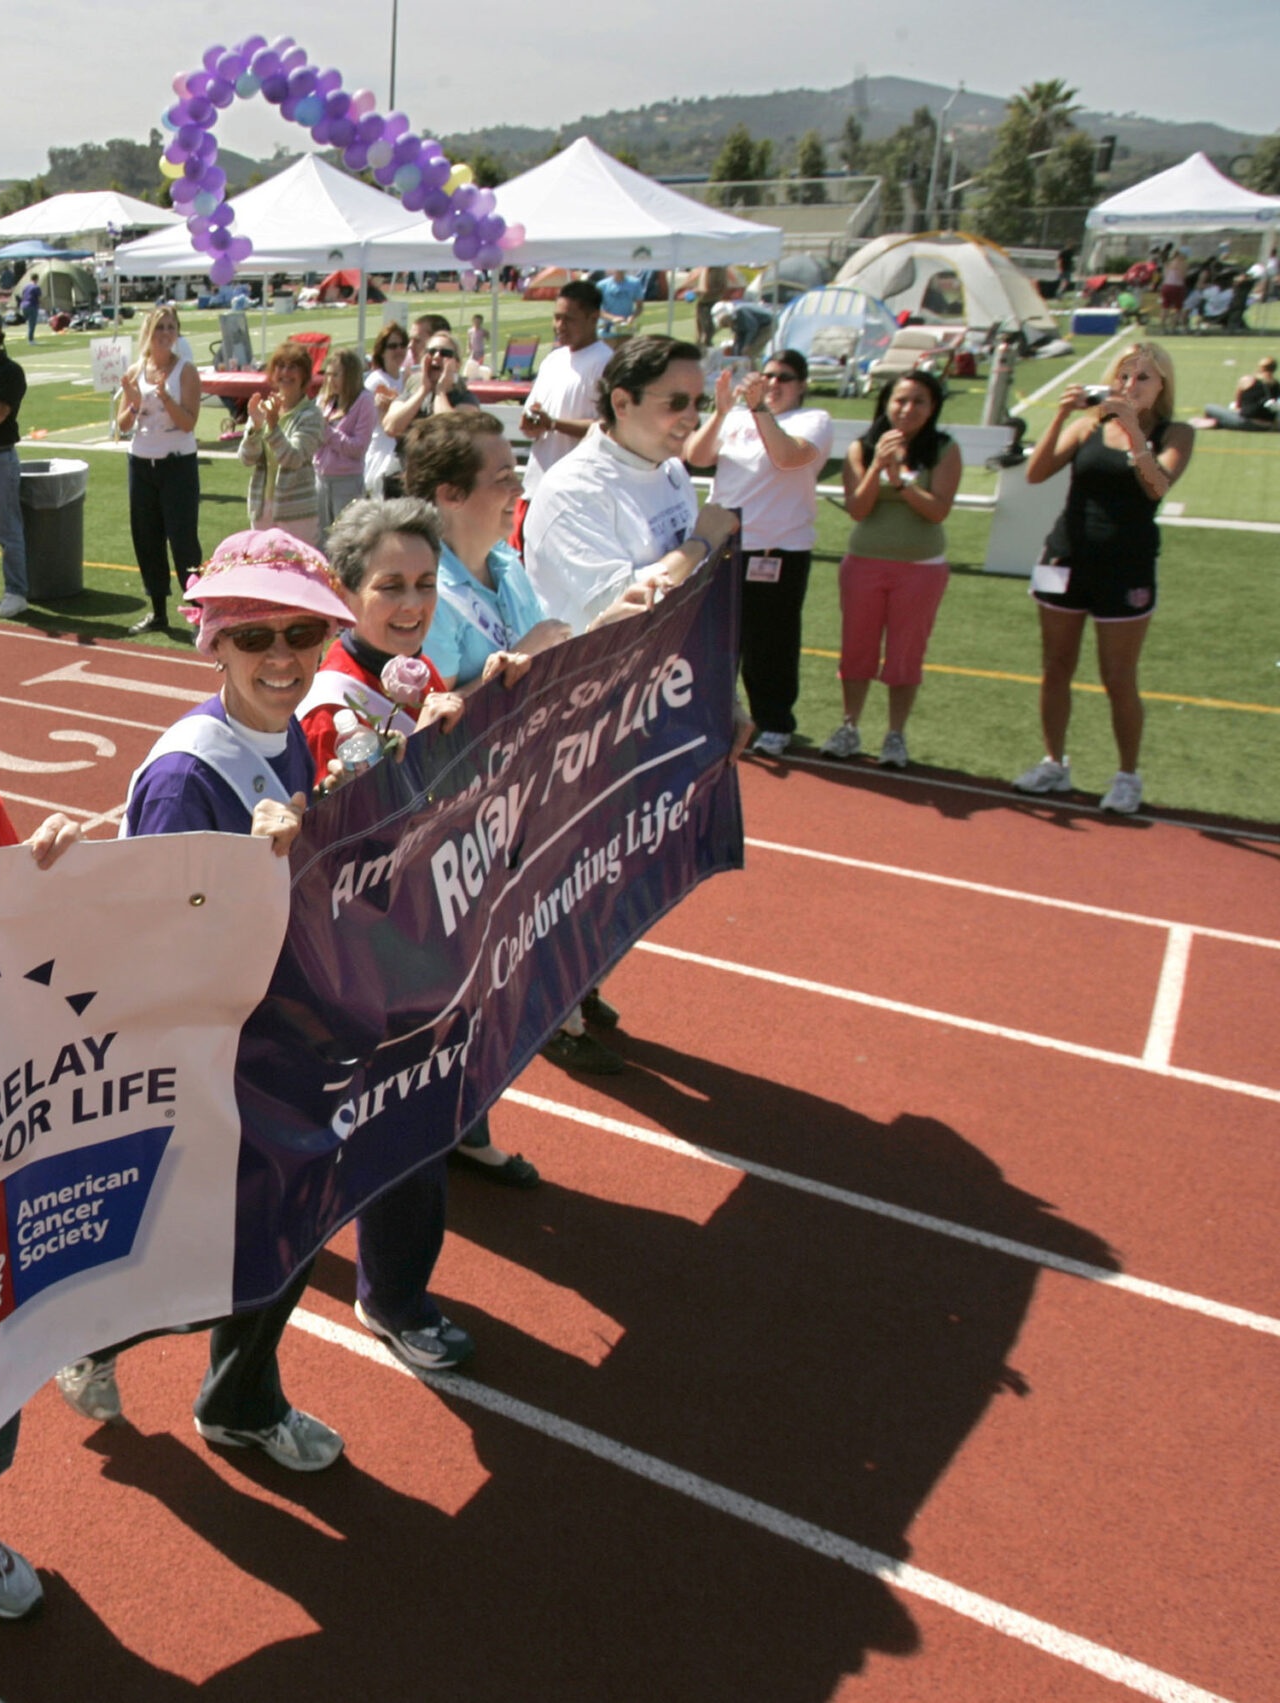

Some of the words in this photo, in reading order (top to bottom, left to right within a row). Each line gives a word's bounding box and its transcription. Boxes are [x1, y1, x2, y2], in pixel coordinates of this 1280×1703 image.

[431, 771, 536, 938] Relay
[540, 711, 610, 806] For
[614, 652, 693, 746] Life
[488, 833, 621, 998] Celebrating
[625, 781, 696, 858] Life!
[72, 1066, 177, 1125] LIFE
[16, 1166, 140, 1226] American
[16, 1198, 104, 1246] Cancer
[19, 1218, 110, 1272] Society
